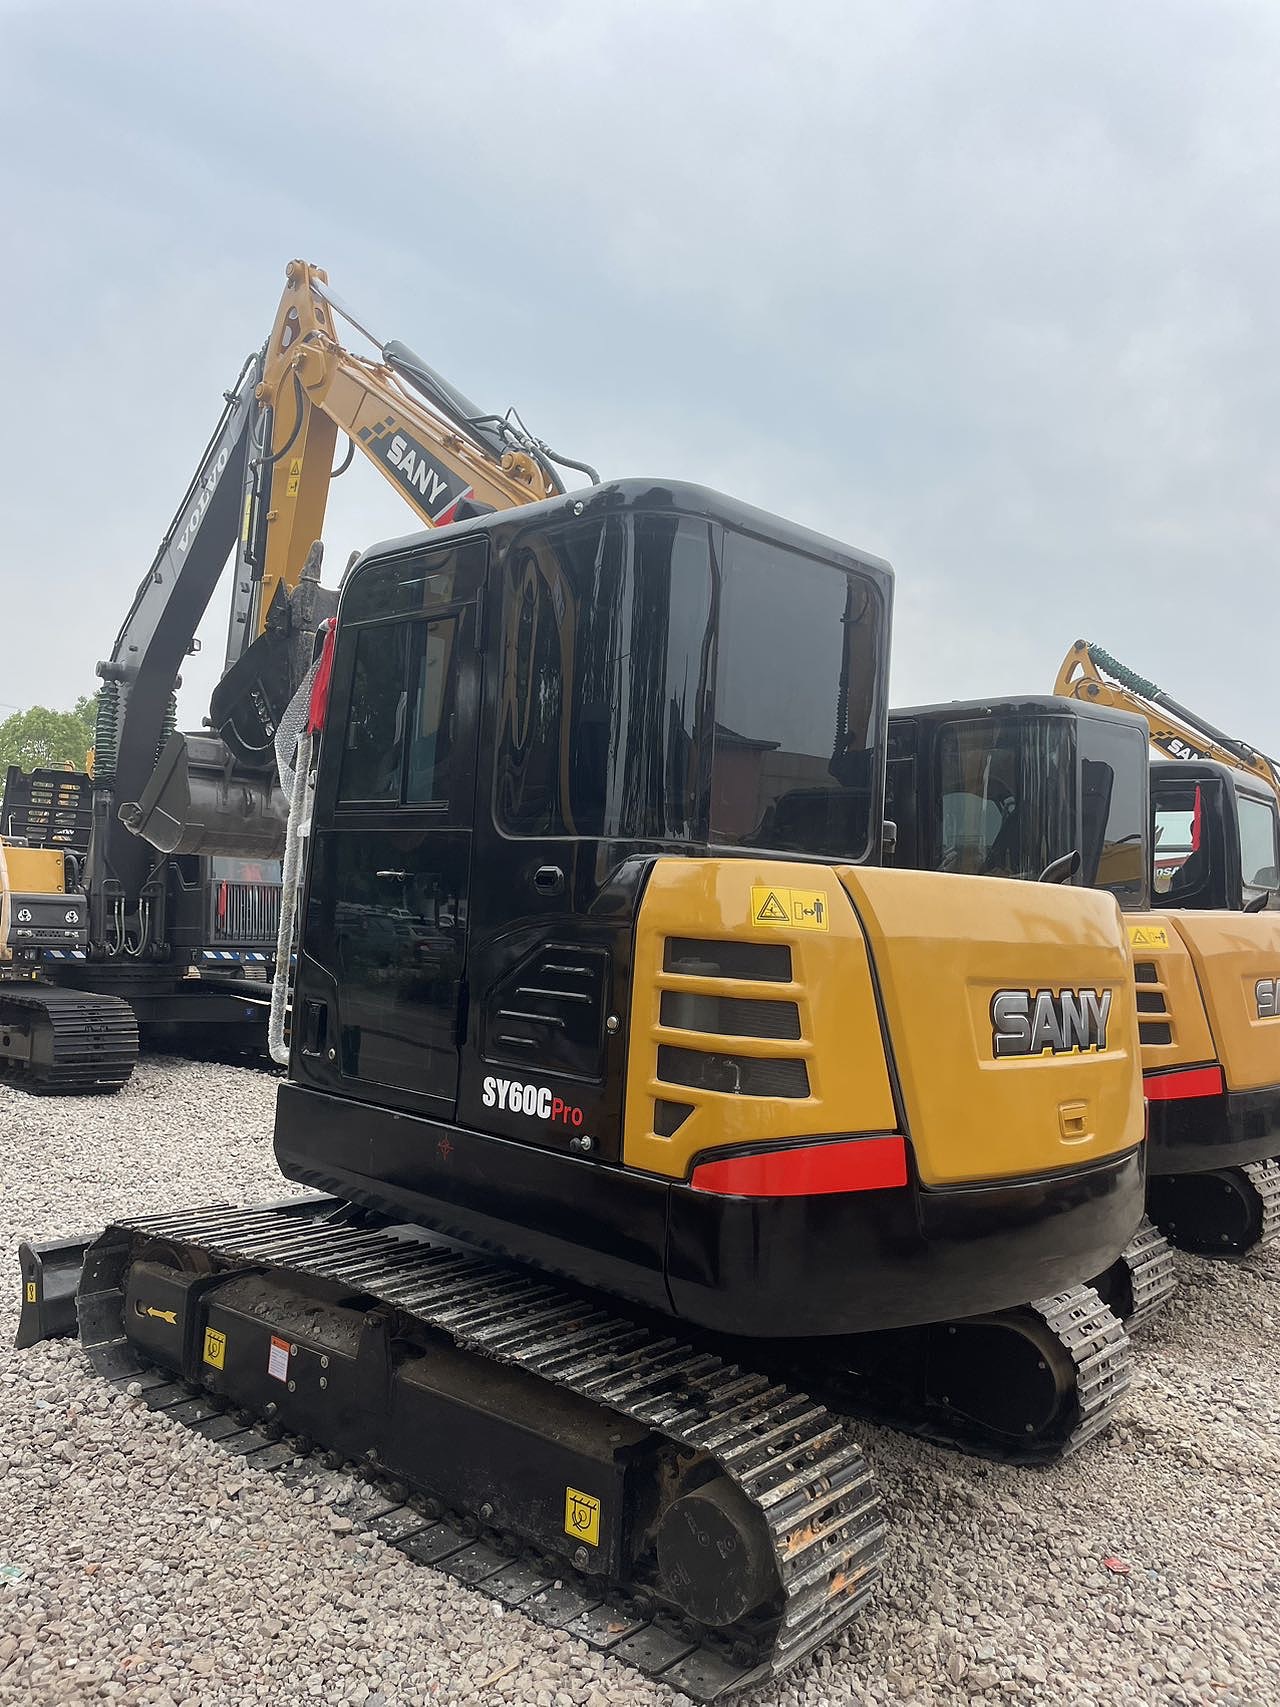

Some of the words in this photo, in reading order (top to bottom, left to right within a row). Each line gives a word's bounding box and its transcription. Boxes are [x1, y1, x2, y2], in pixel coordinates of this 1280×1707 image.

[177, 447, 229, 552] VOLVO
[386, 434, 447, 504] SANY
[990, 988, 1112, 1059] SANY
[1255, 979, 1280, 1020] S
